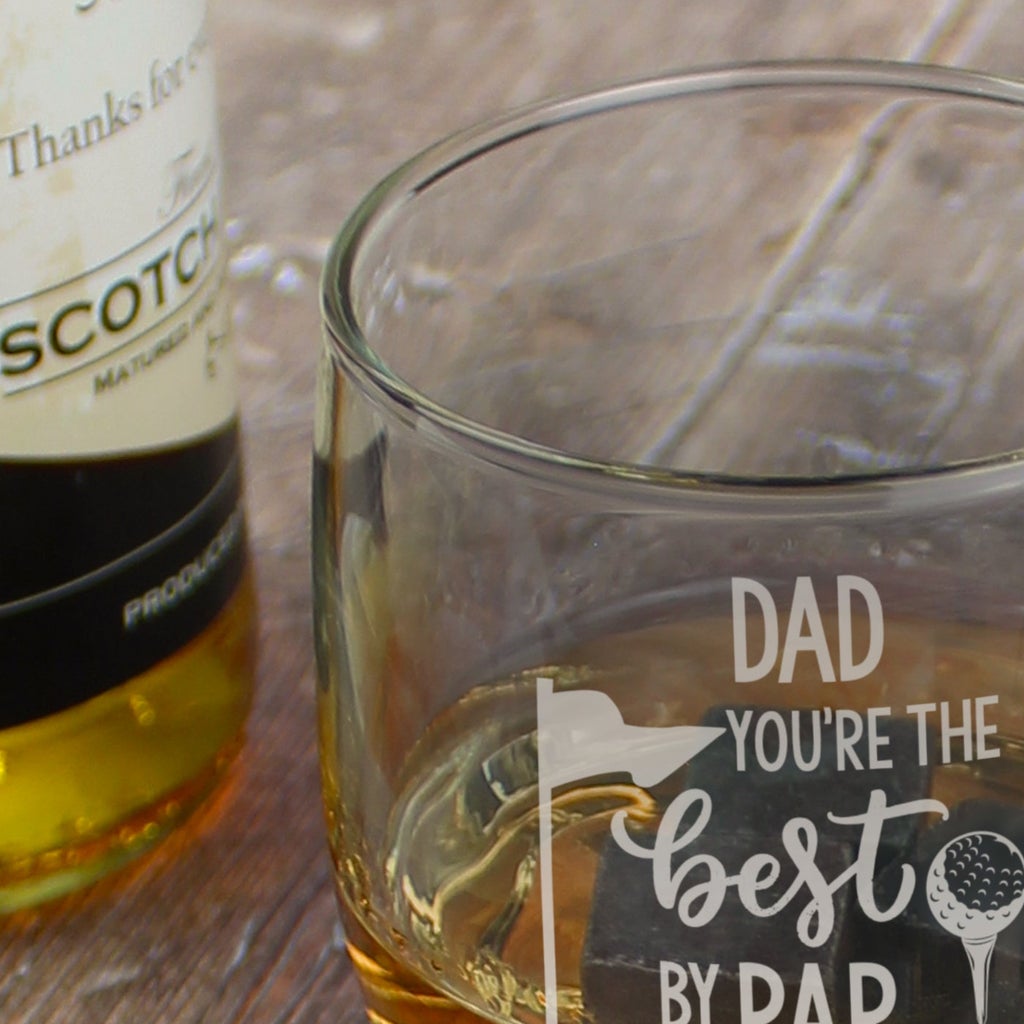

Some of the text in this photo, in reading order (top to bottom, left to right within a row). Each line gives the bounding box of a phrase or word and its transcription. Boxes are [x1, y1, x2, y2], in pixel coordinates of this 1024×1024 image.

[0, 57, 183, 177] Thanks for
[731, 575, 884, 683] DAD
[726, 695, 1001, 772] YOU'RE THE
[611, 788, 949, 947] best
